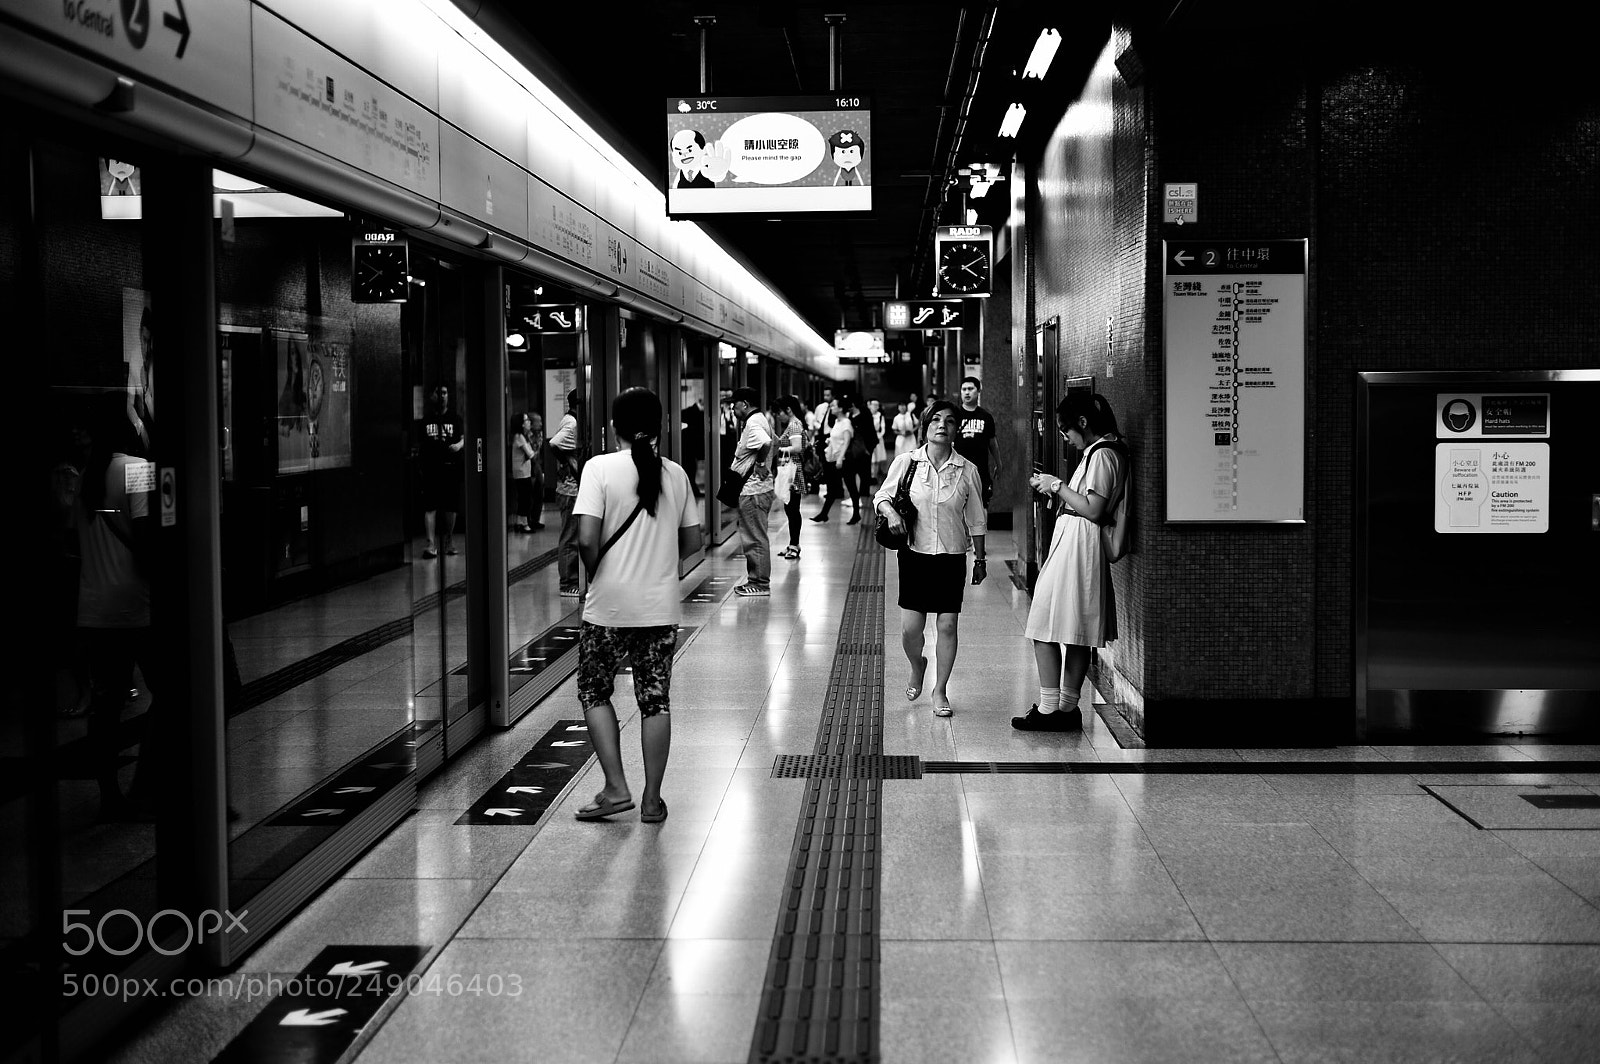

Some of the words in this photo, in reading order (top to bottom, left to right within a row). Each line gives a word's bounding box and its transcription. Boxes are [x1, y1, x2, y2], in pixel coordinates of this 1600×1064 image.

[77, 0, 114, 38] Central
[696, 100, 717, 110] 30°C
[835, 98, 860, 108] 16:10
[744, 139, 799, 150] 請小心空隙
[949, 227, 981, 235] RADO
[1206, 251, 1216, 266] 2
[1227, 247, 1270, 261] 往中環
[1491, 490, 1519, 498] Caution
